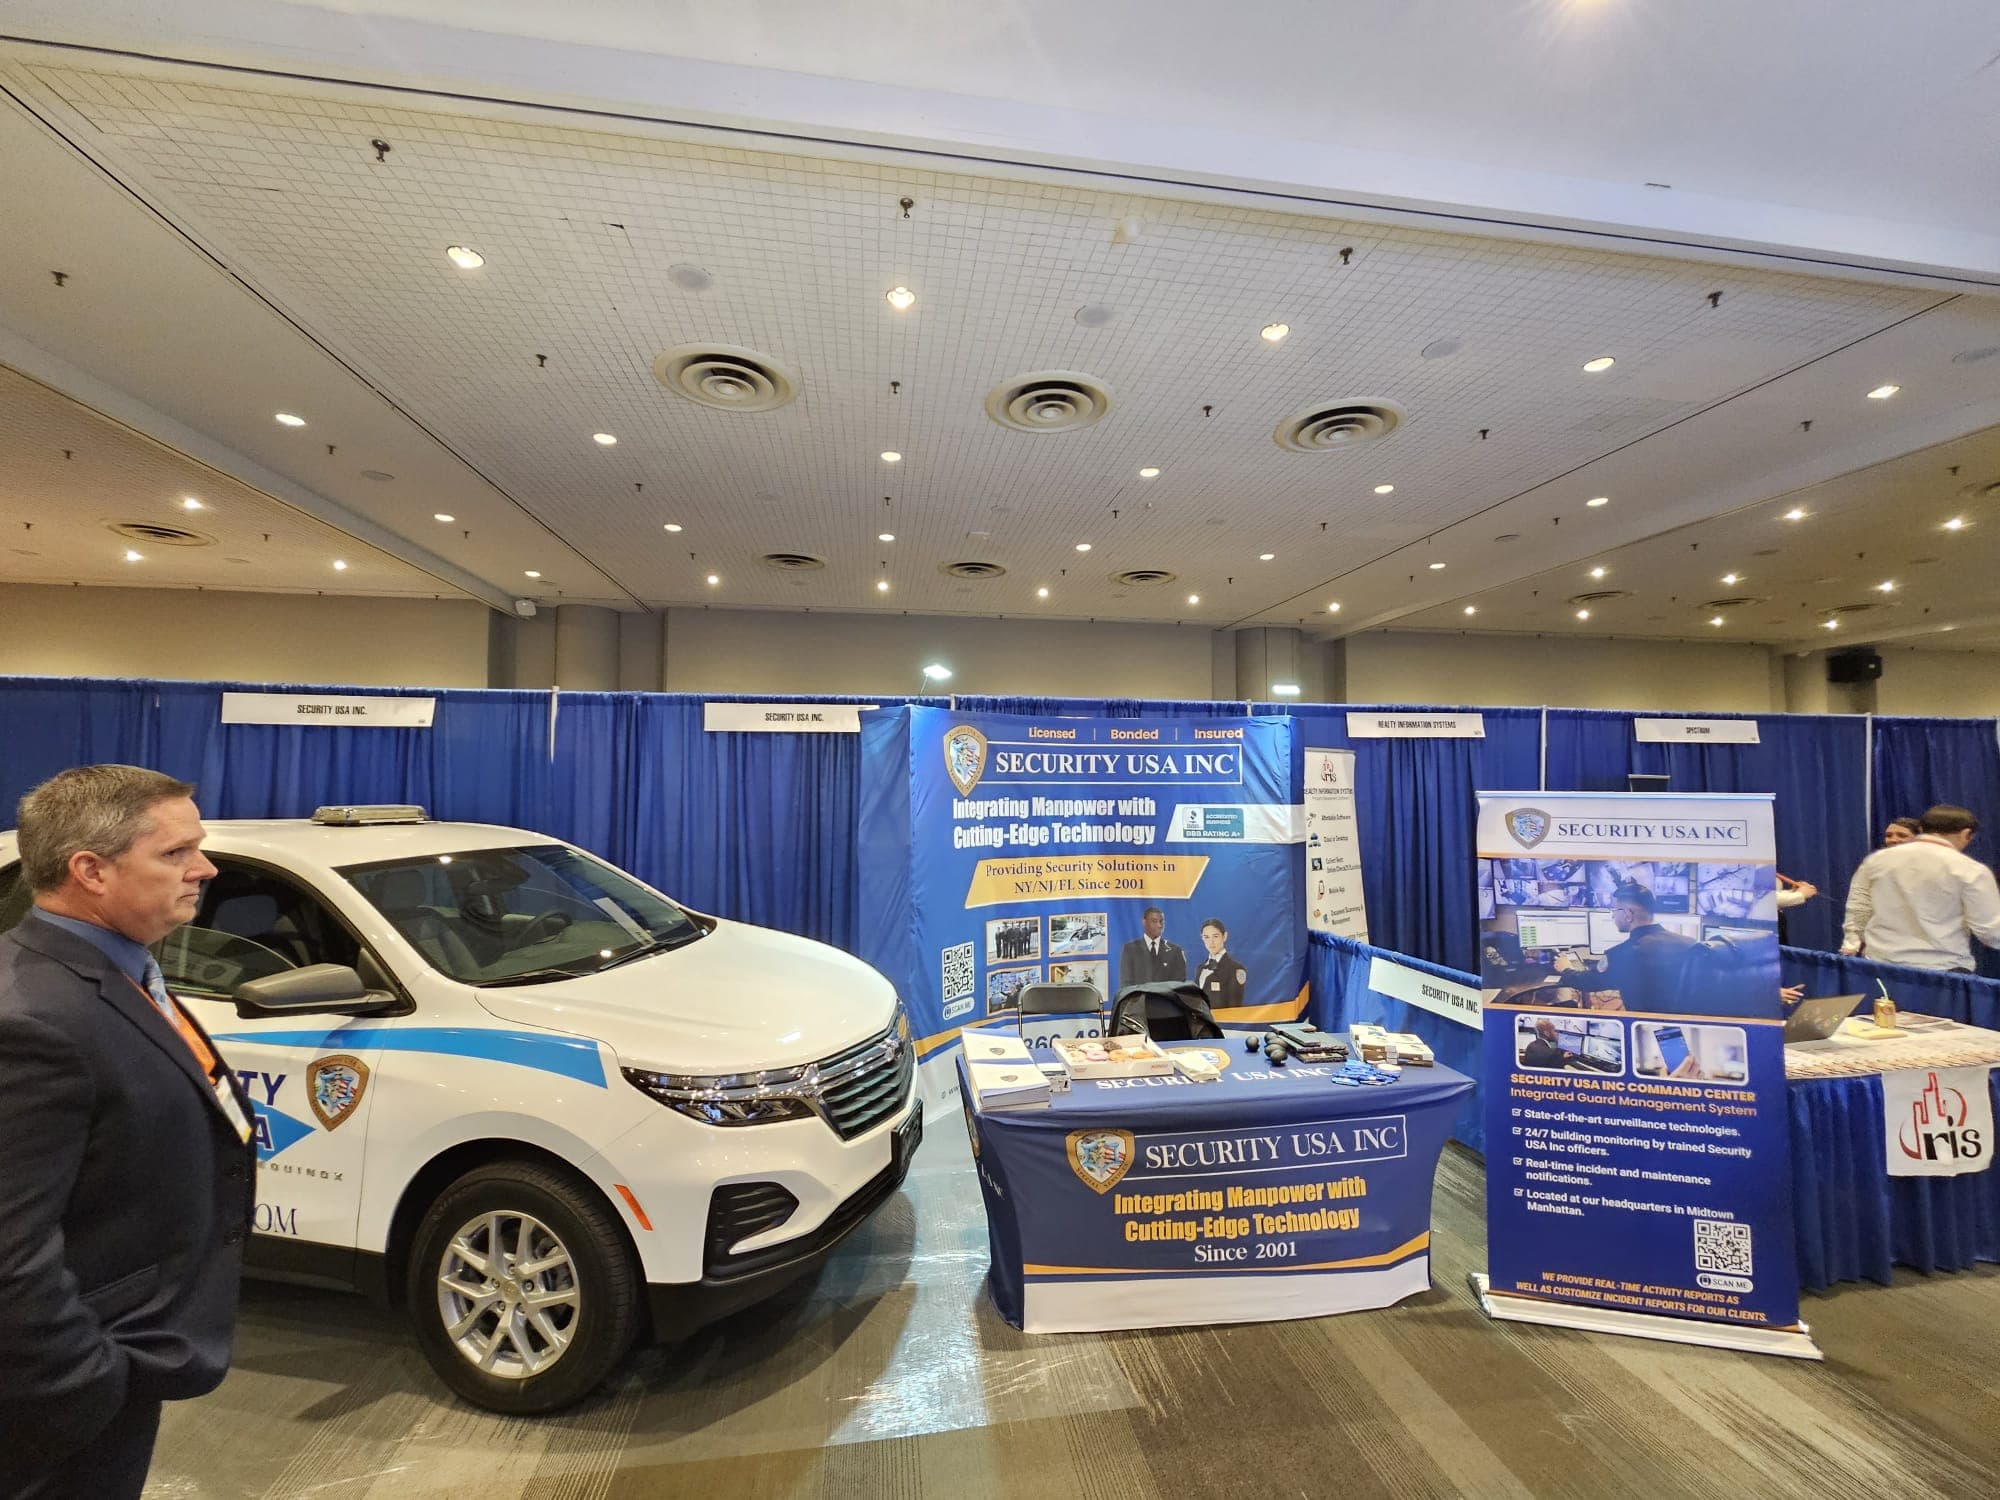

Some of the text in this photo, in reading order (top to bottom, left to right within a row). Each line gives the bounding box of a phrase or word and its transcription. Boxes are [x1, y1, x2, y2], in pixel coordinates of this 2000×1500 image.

[297, 704, 367, 715] SECURITY USA INC.
[765, 713, 824, 721] SECURITY USA INC.
[1029, 727, 1243, 740] Licensed Bonded Insured
[996, 752, 1234, 774] SECURITY USA INC
[953, 797, 1156, 819] Integrating Manpower with
[954, 822, 1155, 849] Cutting-Edge Technology
[1558, 823, 1741, 839] SECURITY USA INC
[986, 860, 1175, 877] Providing Security Solutions in
[1015, 879, 1144, 894] NY/NJ/FL Since 2001
[1422, 984, 1479, 1014] SECURITY USA INC.
[1231, 1071, 1284, 1082] USA
[1288, 1067, 1332, 1078] INC
[1510, 1074, 1756, 1102] SECURITY USA INC COMMAND CENTER
[1510, 1087, 1757, 1116] Integrated Guard Management System
[1525, 1109, 1740, 1137] State-of-the-art surveillance technologies.
[1146, 1126, 1398, 1168] SECURITY USA INC
[1525, 1128, 1752, 1158] 24/7 building monitoring by trained Security
[1525, 1140, 1610, 1156] USA Inc officers.
[1526, 1158, 1711, 1185] Real-time incident and maintenance
[1526, 1171, 1593, 1186] notifications.
[1114, 1176, 1367, 1215] Integrating Manpower with
[1527, 1189, 1734, 1220] Located at our headquarters in Midtown
[1527, 1201, 1585, 1216] Manhattan.
[1125, 1207, 1360, 1242] Cutting-Edge Technology
[1194, 1242, 1297, 1263] Since 2001
[1542, 1272, 1739, 1305] WE PROVIDE REAL-TIME ACTIVITY REPORTS AS
[1712, 1278, 1749, 1289] SCAN ME
[1516, 1281, 1768, 1322] WELL AS CUSTOMIZE INCIDENT REPORTS FOR OUR CLIENTS.
